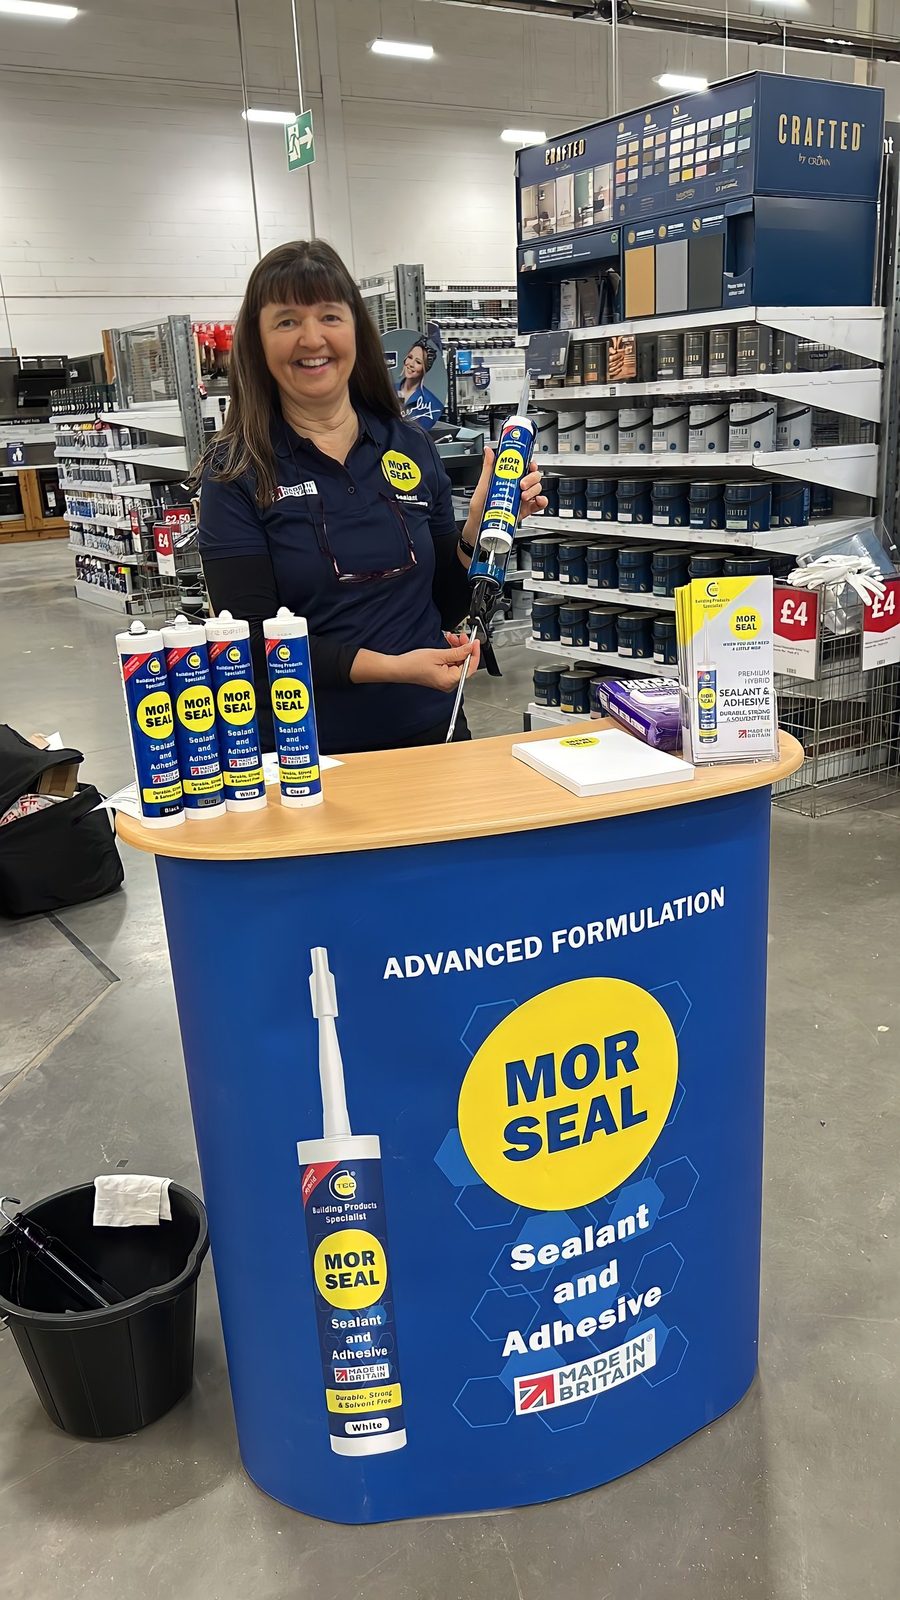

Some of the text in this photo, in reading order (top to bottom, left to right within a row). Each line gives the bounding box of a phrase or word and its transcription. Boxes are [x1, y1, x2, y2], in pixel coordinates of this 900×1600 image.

[778, 113, 861, 151] CRAFTED
[545, 139, 586, 166] CRAFTED
[798, 153, 831, 166] by CROWN
[388, 460, 411, 470] MOR
[500, 457, 520, 465] MOR
[498, 463, 519, 474] SEAL
[389, 470, 416, 480] SEAL
[158, 533, 169, 547] £4
[871, 590, 896, 619] £4
[780, 598, 808, 626] £4
[735, 623, 757, 631] SEAL
[223, 691, 250, 702] MOR
[275, 689, 301, 699] MOR
[719, 687, 770, 697] SEALANT &
[184, 696, 210, 709] MOR
[223, 702, 252, 713] SEAL
[275, 700, 304, 711] SEAL
[723, 697, 770, 707] ADHESIVE
[145, 702, 170, 716] MOR
[184, 708, 213, 720] SEAL
[145, 714, 172, 727] SEAL
[227, 728, 254, 737] Sealant
[197, 744, 211, 752] and
[227, 746, 258, 754] Adhesive
[280, 744, 309, 752] Adhesive
[159, 751, 172, 760] and
[164, 805, 179, 813] Black
[383, 886, 726, 980] ADVANCED FORMULATION
[505, 1030, 640, 1107] MOR
[502, 1085, 648, 1161] SEAL
[312, 1202, 377, 1214] Building Products
[325, 1212, 367, 1224] Specialist
[510, 1204, 649, 1271] Sealant
[324, 1250, 376, 1270] MOR
[325, 1270, 380, 1290] SEAL
[553, 1259, 618, 1304] and
[331, 1314, 382, 1329] Sealant
[502, 1286, 662, 1357] Adhesive
[345, 1331, 371, 1344] and
[332, 1346, 388, 1360] Adhesive
[558, 1337, 646, 1385] MADE IN
[348, 1367, 371, 1375] MADE
[349, 1371, 386, 1381] BRITAIN
[559, 1353, 646, 1402] BRITAIN
[335, 1390, 392, 1401] Durable, Strong
[345, 1401, 375, 1409] Solvent
[351, 1421, 382, 1431] White
